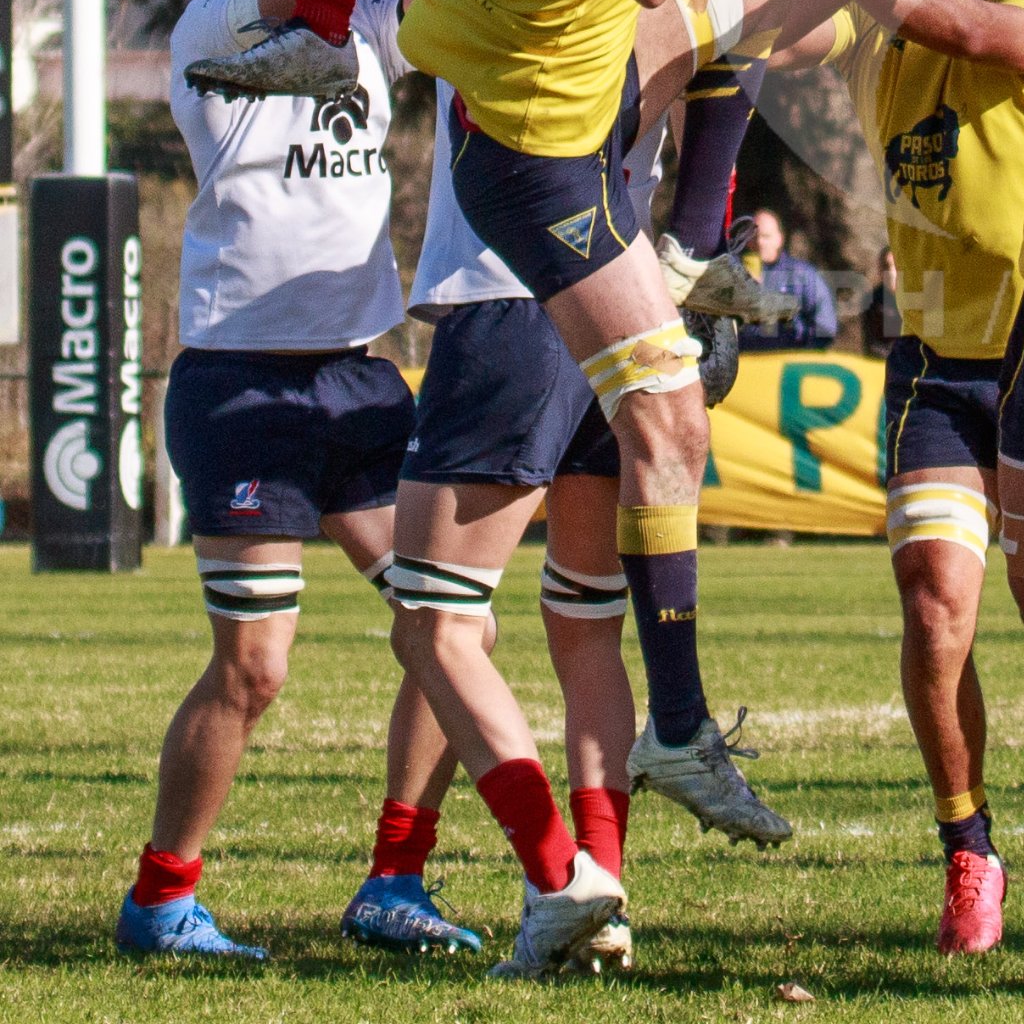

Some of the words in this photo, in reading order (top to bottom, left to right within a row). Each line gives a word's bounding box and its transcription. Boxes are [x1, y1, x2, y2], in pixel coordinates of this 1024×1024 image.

[901, 133, 943, 155] PASO
[53, 239, 96, 413] Macro
[120, 236, 141, 413] Macro
